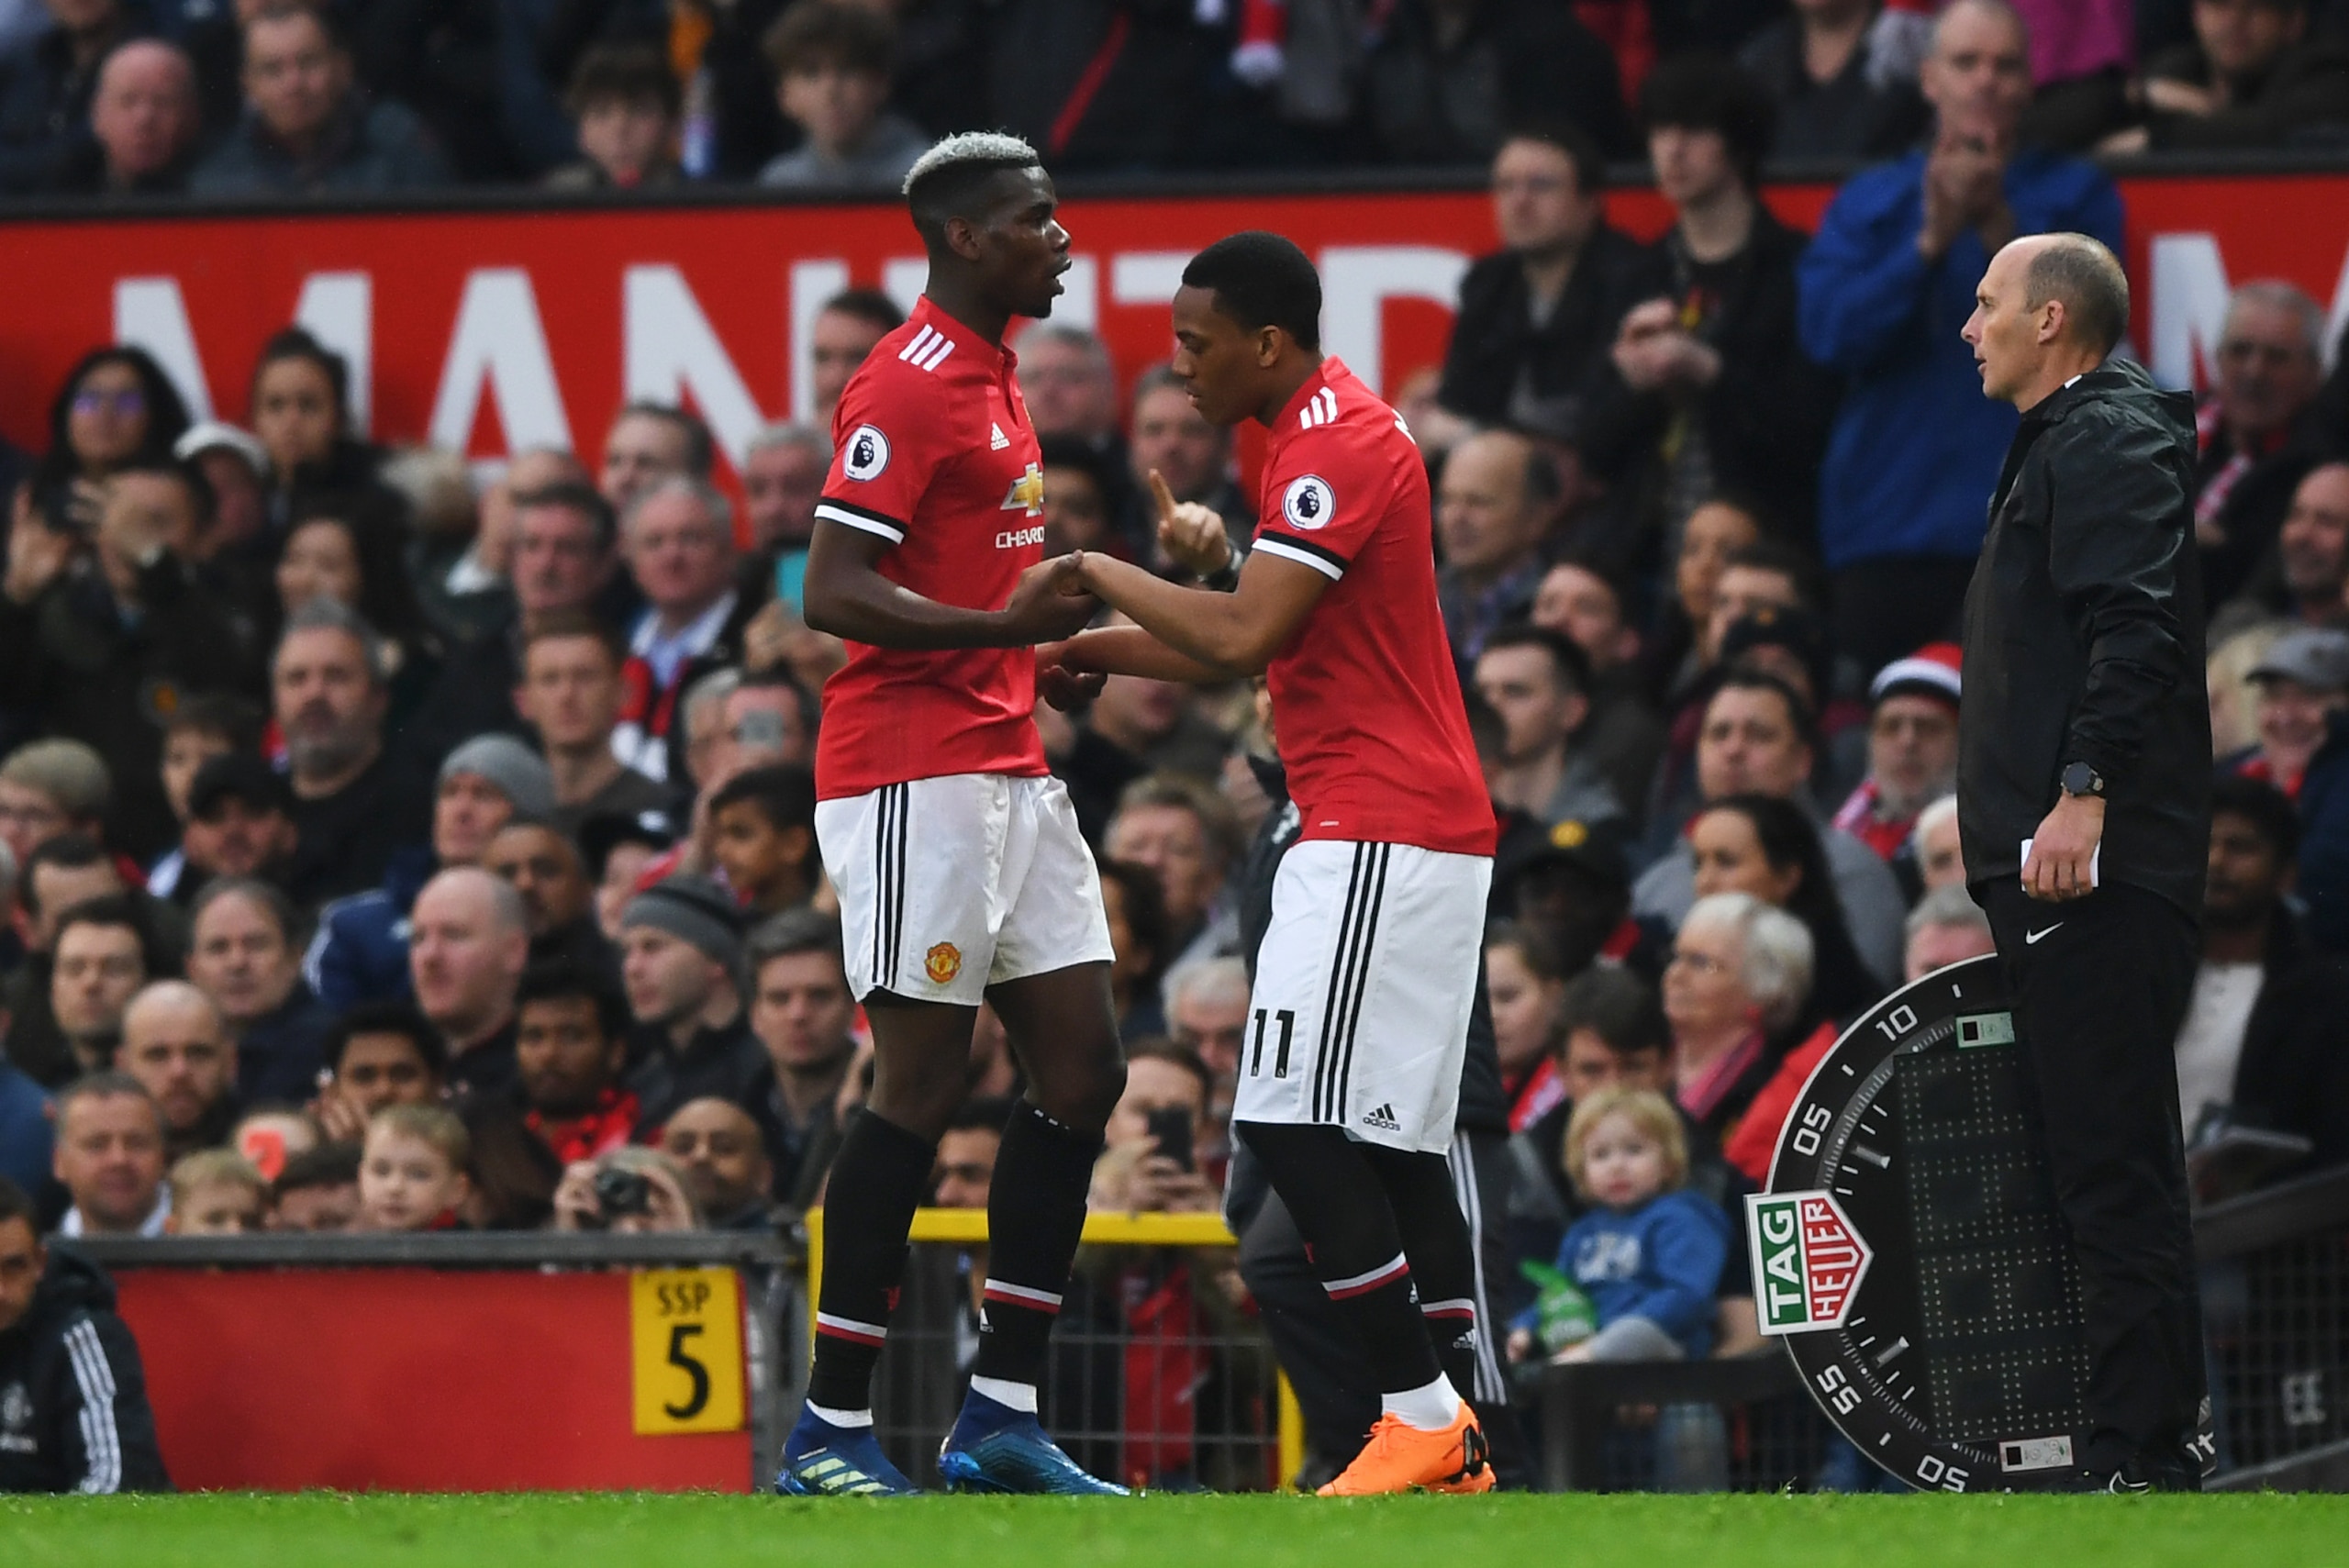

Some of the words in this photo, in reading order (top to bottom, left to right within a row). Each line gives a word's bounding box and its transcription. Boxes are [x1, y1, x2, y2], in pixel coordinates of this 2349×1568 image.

[1250, 1008, 1295, 1079] 11
[1875, 1005, 1919, 1041] 10
[1363, 1117, 1401, 1131] adidas
[1792, 1102, 1832, 1157] 05
[1762, 1208, 1802, 1320] TAG
[1804, 1202, 1860, 1318] HEUER
[656, 1282, 711, 1316] SSP
[663, 1324, 710, 1419] 5
[1816, 1364, 1863, 1416] 55
